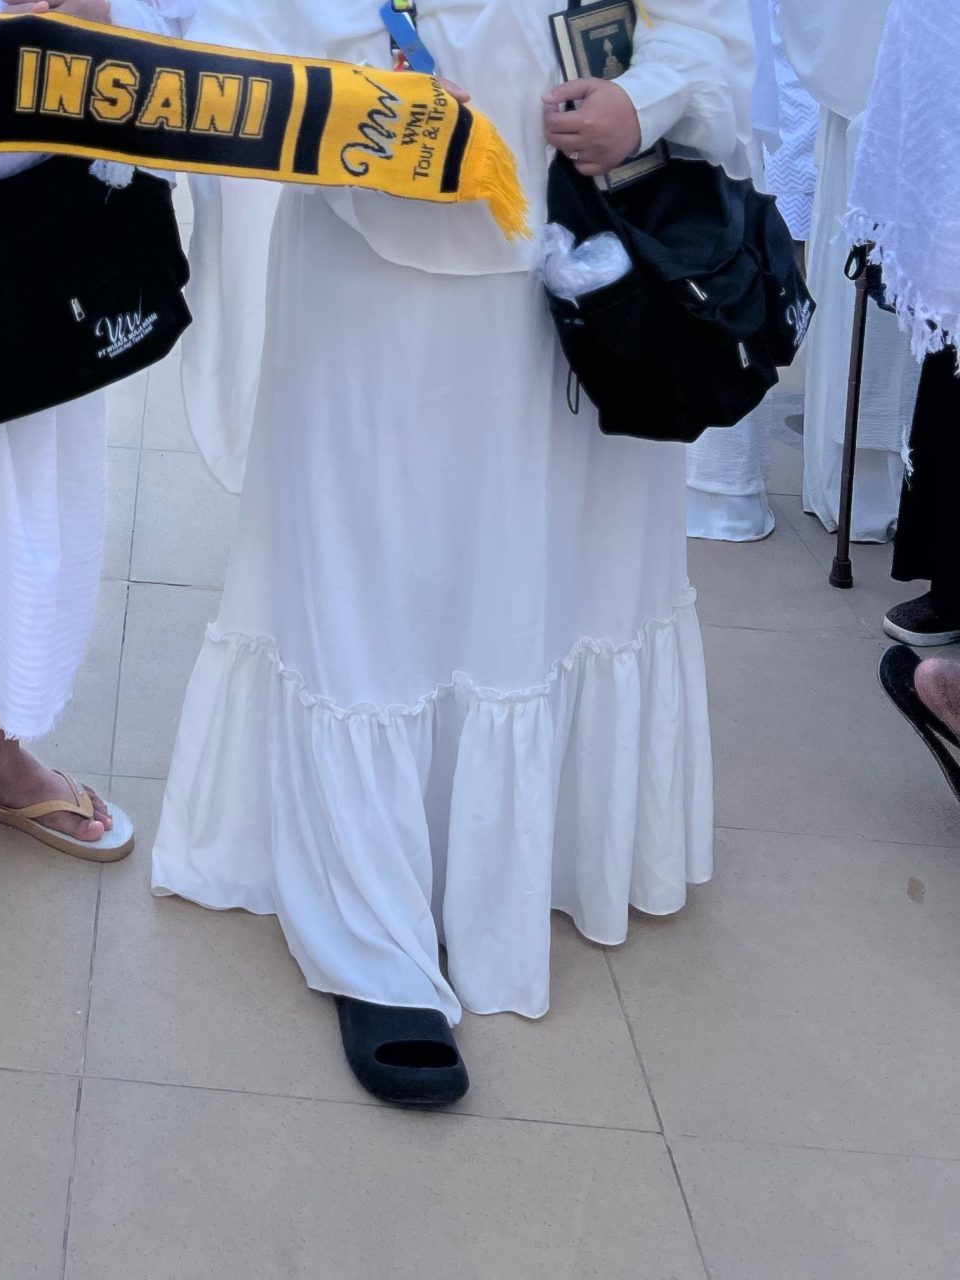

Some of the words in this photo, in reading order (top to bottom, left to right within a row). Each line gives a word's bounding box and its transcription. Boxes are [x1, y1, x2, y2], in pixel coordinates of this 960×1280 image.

[16, 47, 272, 139] INSANI
[401, 104, 428, 146] WMI
[422, 126, 440, 141] &
[413, 143, 435, 180] Tour
